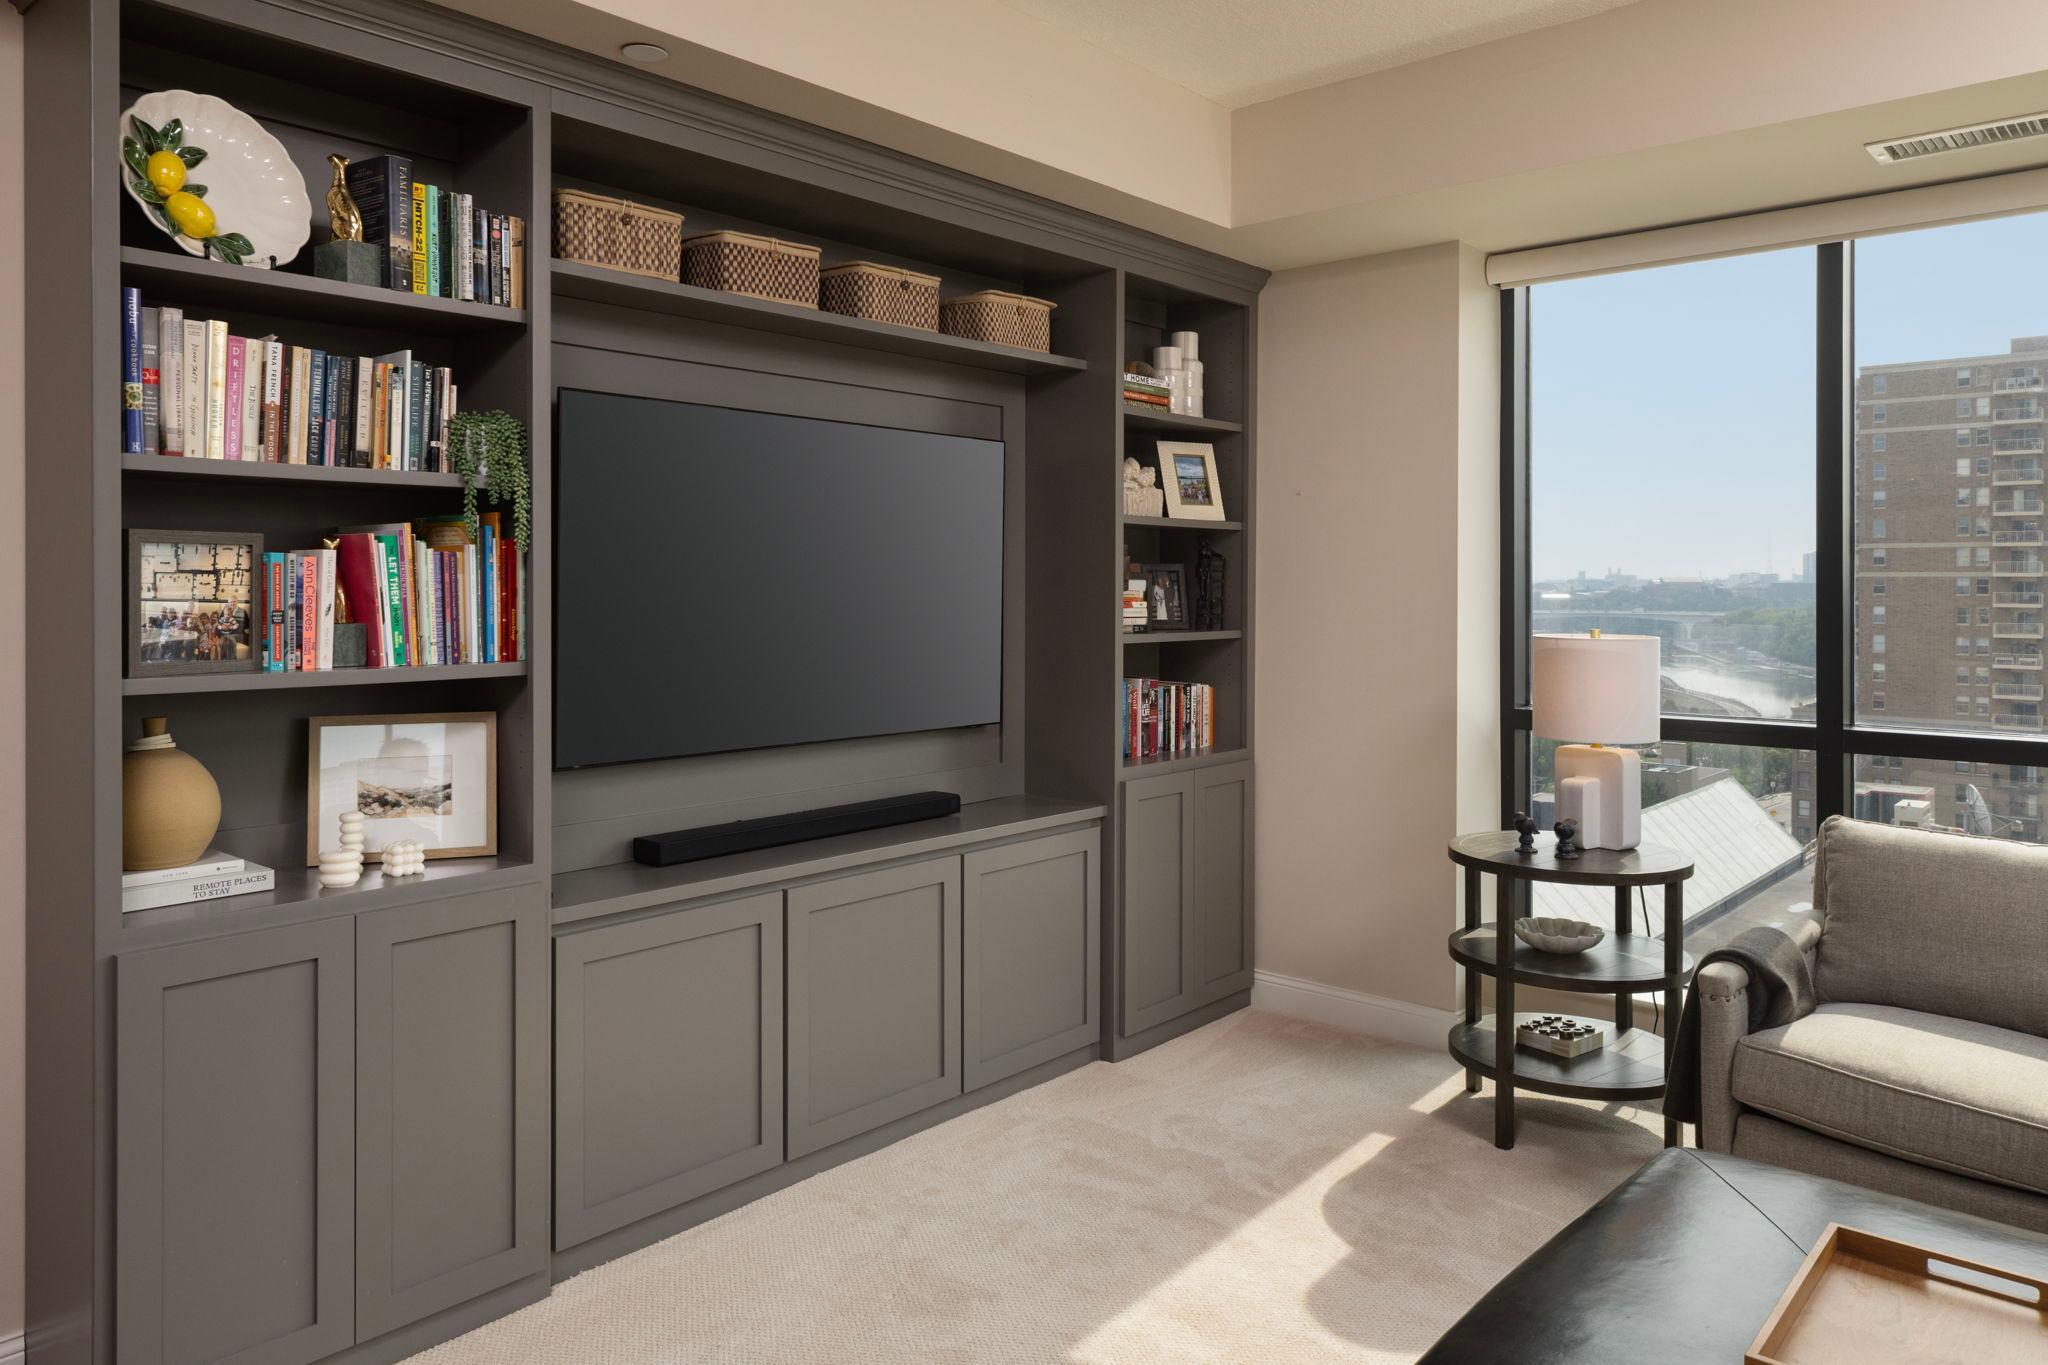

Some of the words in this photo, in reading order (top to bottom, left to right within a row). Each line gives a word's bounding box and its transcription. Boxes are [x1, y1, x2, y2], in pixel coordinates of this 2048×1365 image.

[398, 166, 408, 236] FAMILIARIS
[128, 297, 139, 324] nobu
[314, 353, 322, 366] THE
[313, 368, 321, 398] TERMINAL
[1131, 375, 1149, 384] HOME
[230, 347, 240, 452] DRIFTLESS
[312, 399, 320, 413] LIST
[360, 380, 369, 439] EVICTED
[306, 560, 314, 584] Ann
[388, 557, 397, 574] LET
[390, 578, 399, 604] THEM
[305, 585, 315, 632] Cleeves
[193, 880, 232, 891] REMOTE
[234, 875, 267, 885] PLACES
[209, 887, 231, 896] STAY
